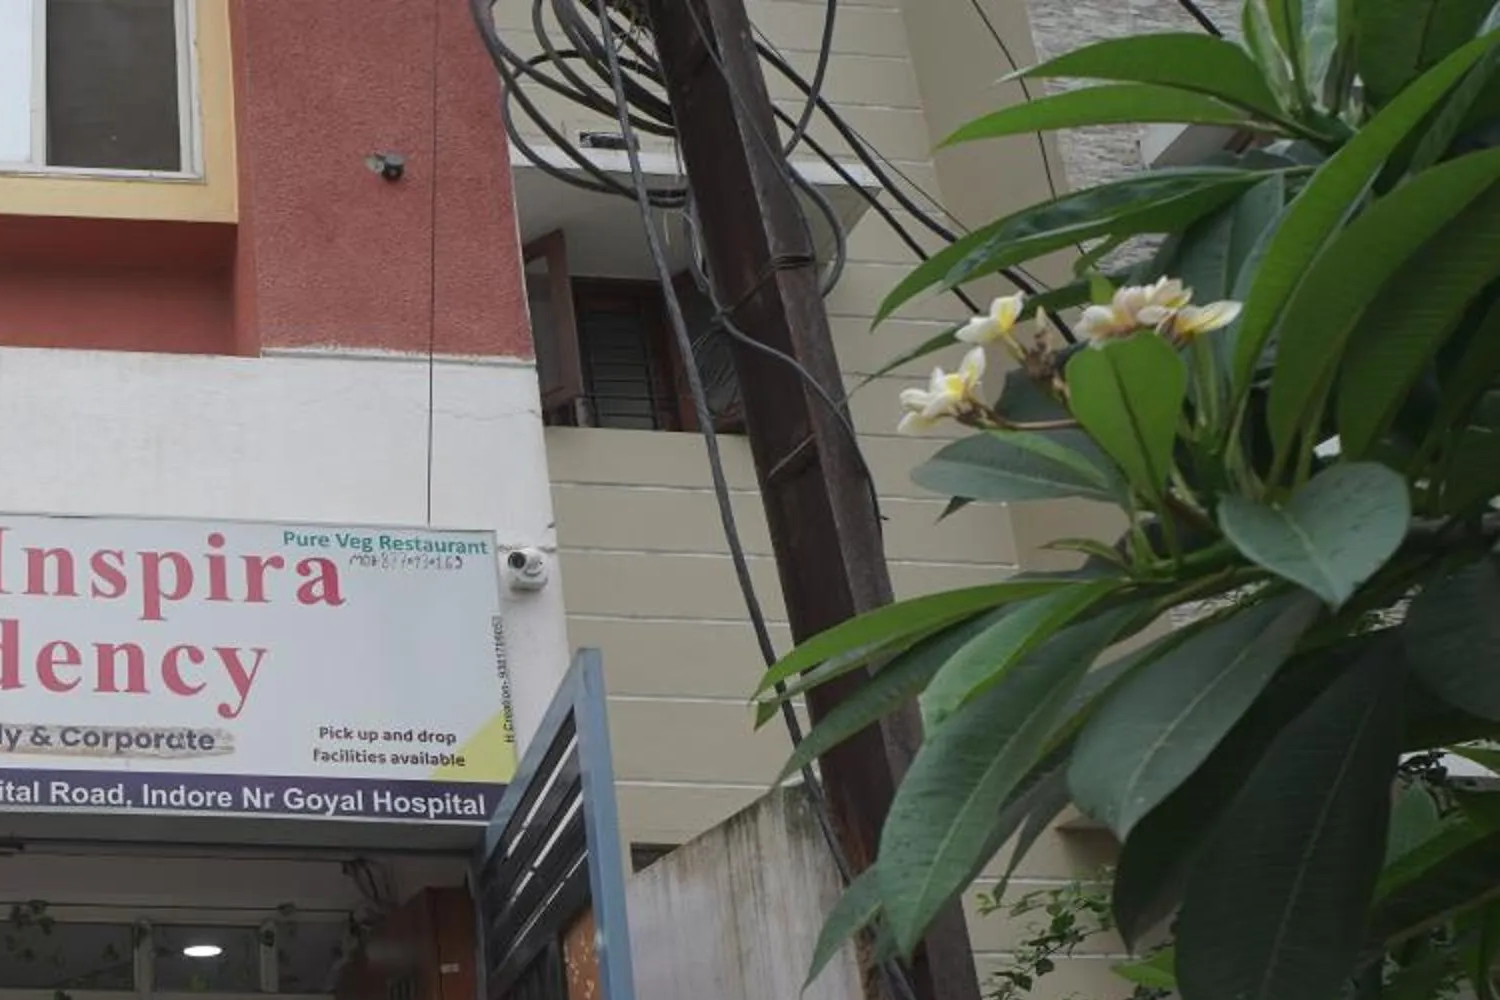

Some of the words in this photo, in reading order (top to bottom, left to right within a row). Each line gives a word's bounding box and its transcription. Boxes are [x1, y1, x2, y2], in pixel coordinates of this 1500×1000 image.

[283, 531, 330, 547] Pure
[334, 533, 373, 552] Veg
[379, 535, 489, 555] Restaurant
[30, 726, 52, 747] &
[60, 727, 215, 751] Corporate
[319, 727, 351, 740] Pick
[358, 732, 378, 743] up
[383, 730, 413, 743] and
[417, 730, 457, 746] drop
[313, 749, 386, 764] Facilities
[390, 752, 465, 767] available
[142, 783, 233, 808] Indore
[242, 786, 274, 809] Nr
[283, 787, 364, 816] Goyal
[372, 791, 485, 818] Hospital
